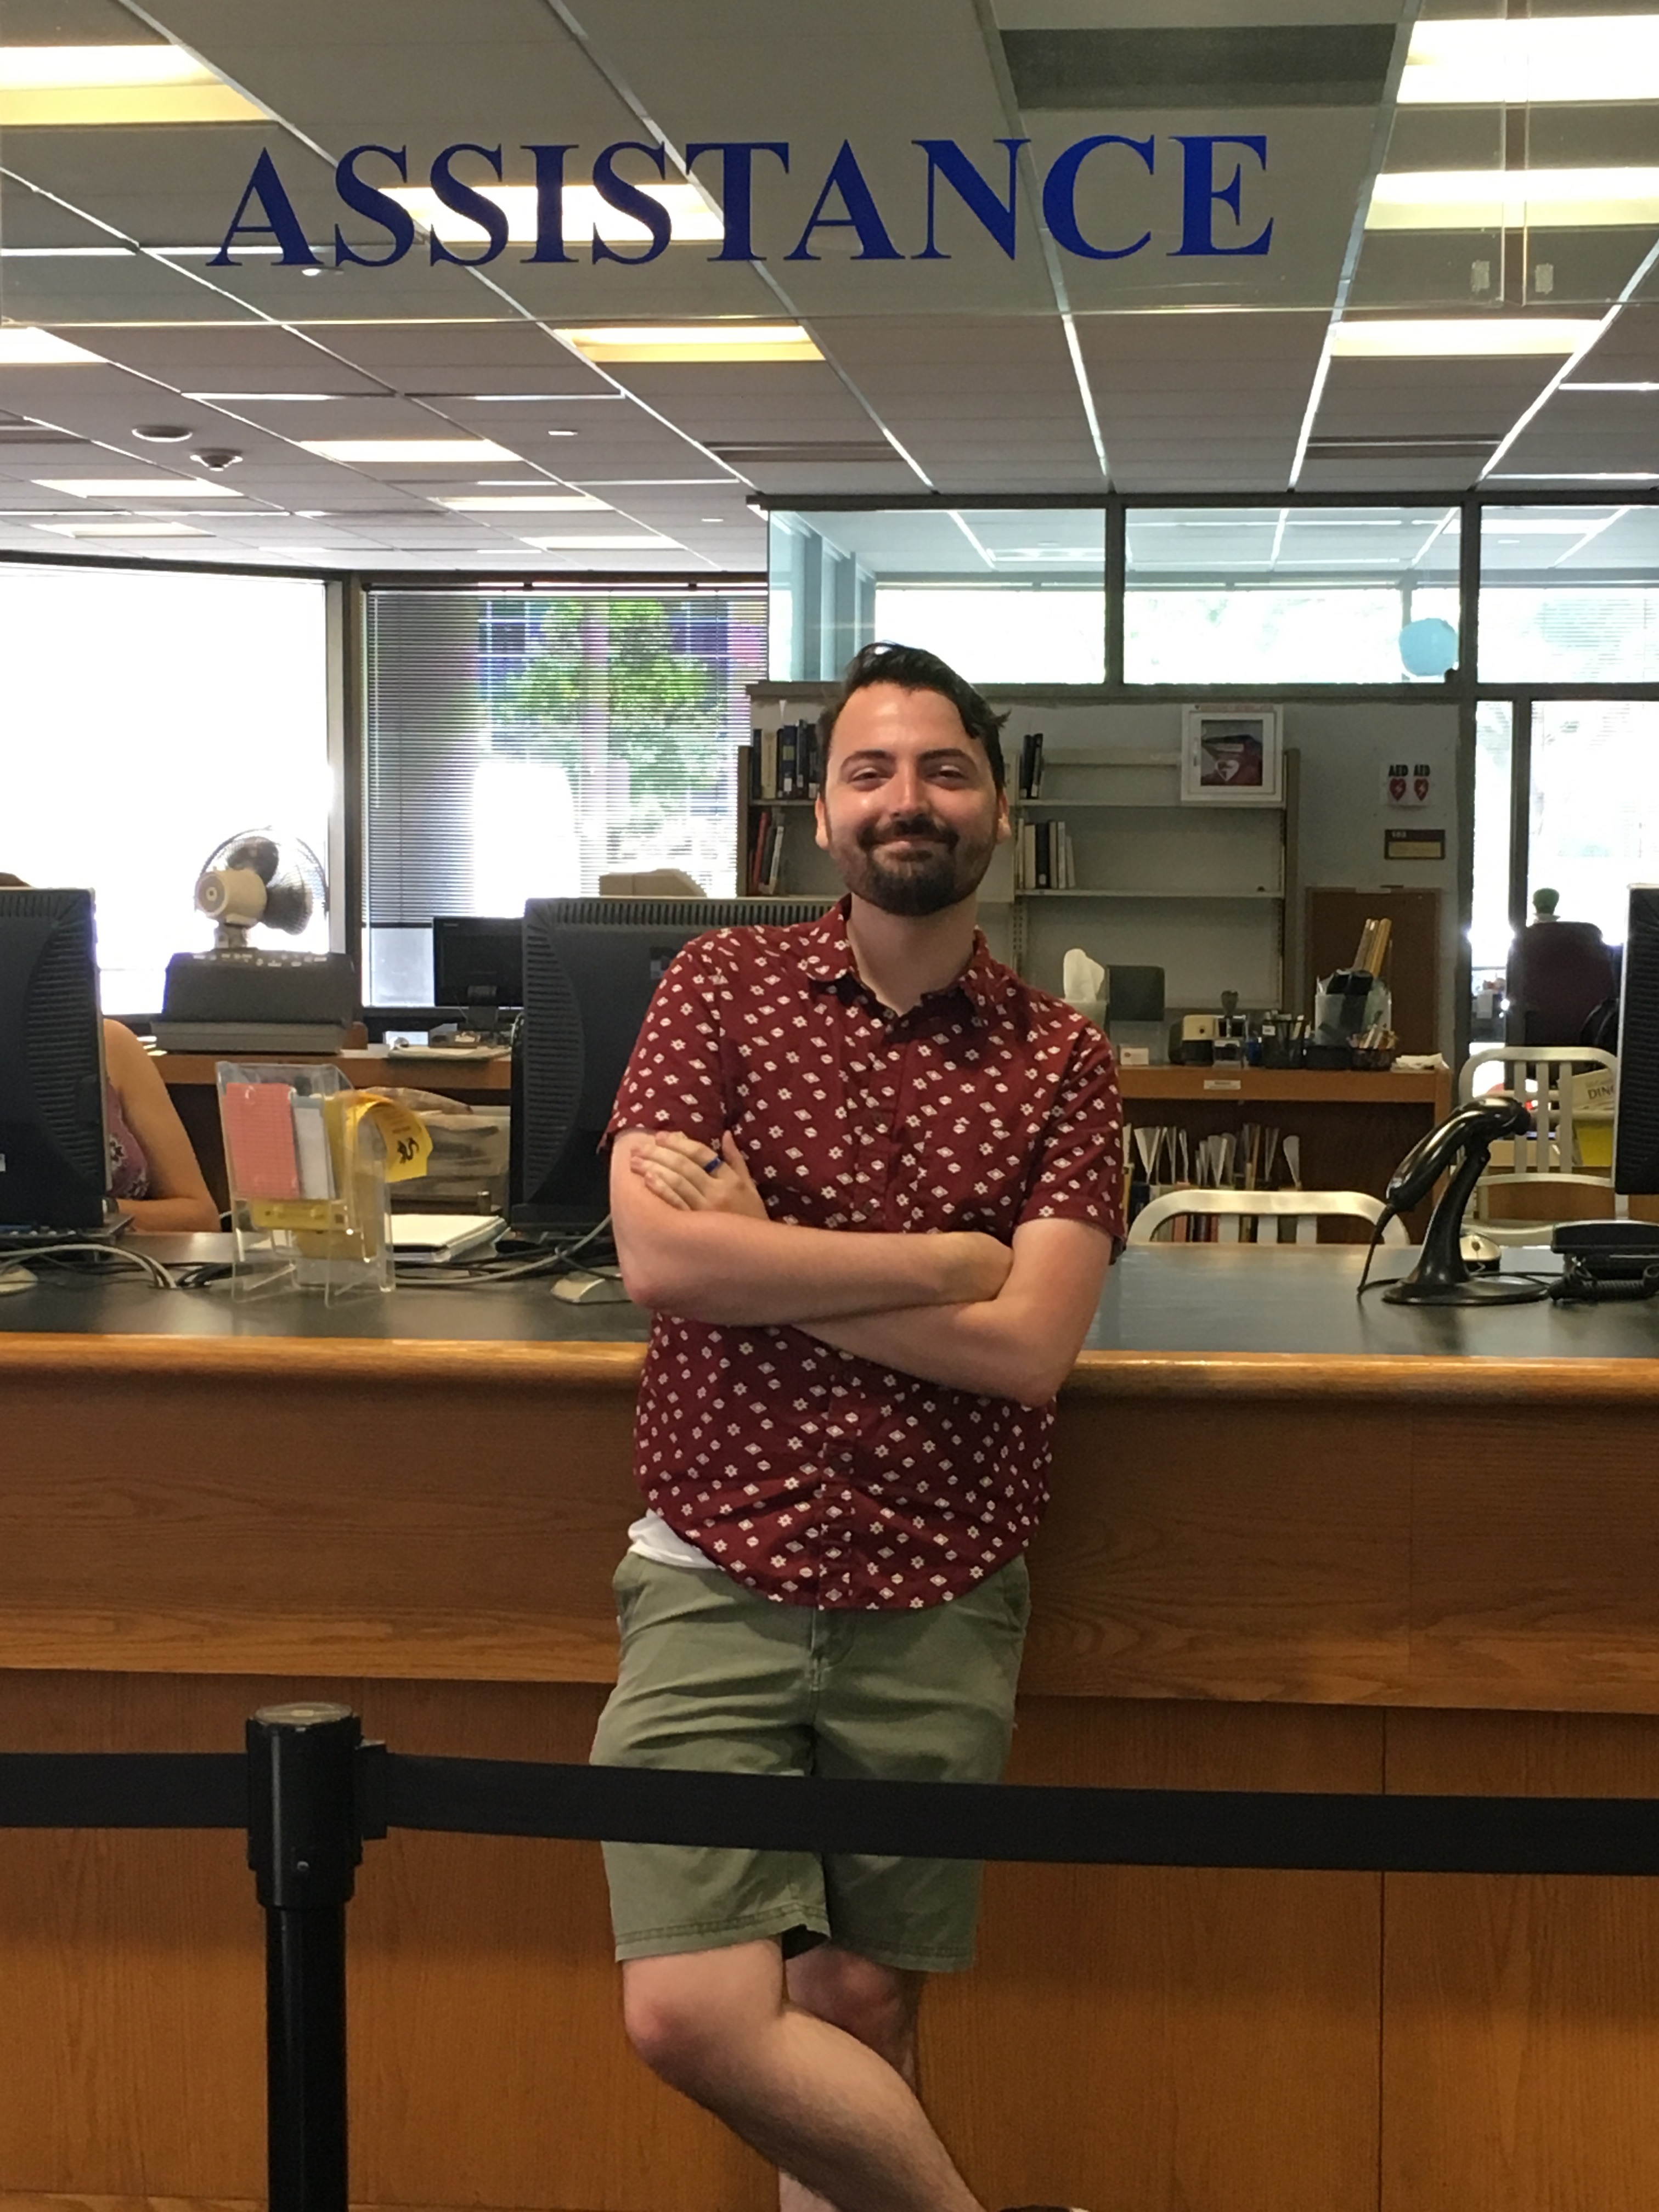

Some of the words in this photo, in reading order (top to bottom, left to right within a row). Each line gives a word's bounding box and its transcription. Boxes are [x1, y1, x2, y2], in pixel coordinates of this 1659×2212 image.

[205, 134, 1273, 267] ASSISTANCE
[1388, 764, 1409, 777] AED
[1413, 764, 1431, 777] AED
